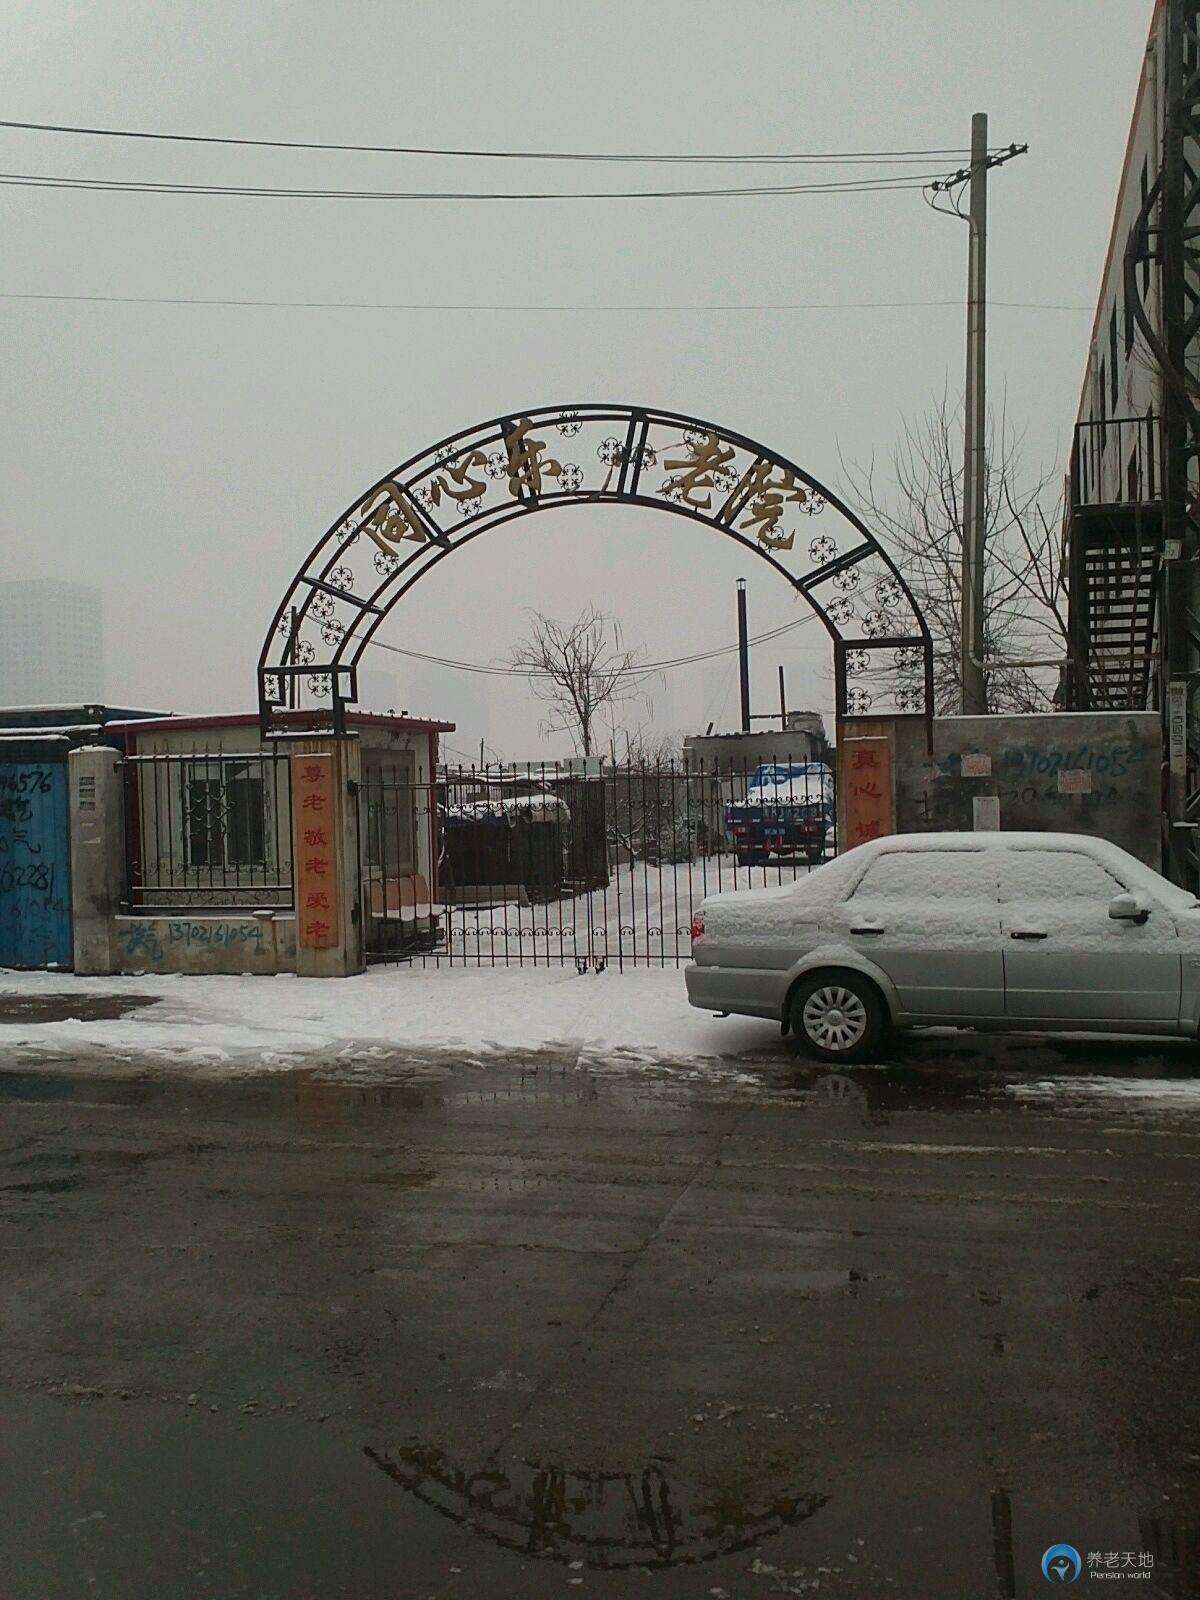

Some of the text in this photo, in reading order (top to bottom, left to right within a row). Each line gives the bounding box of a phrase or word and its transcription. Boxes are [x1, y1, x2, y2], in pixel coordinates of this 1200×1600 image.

[301, 765, 331, 939] 尊老敬老爱老
